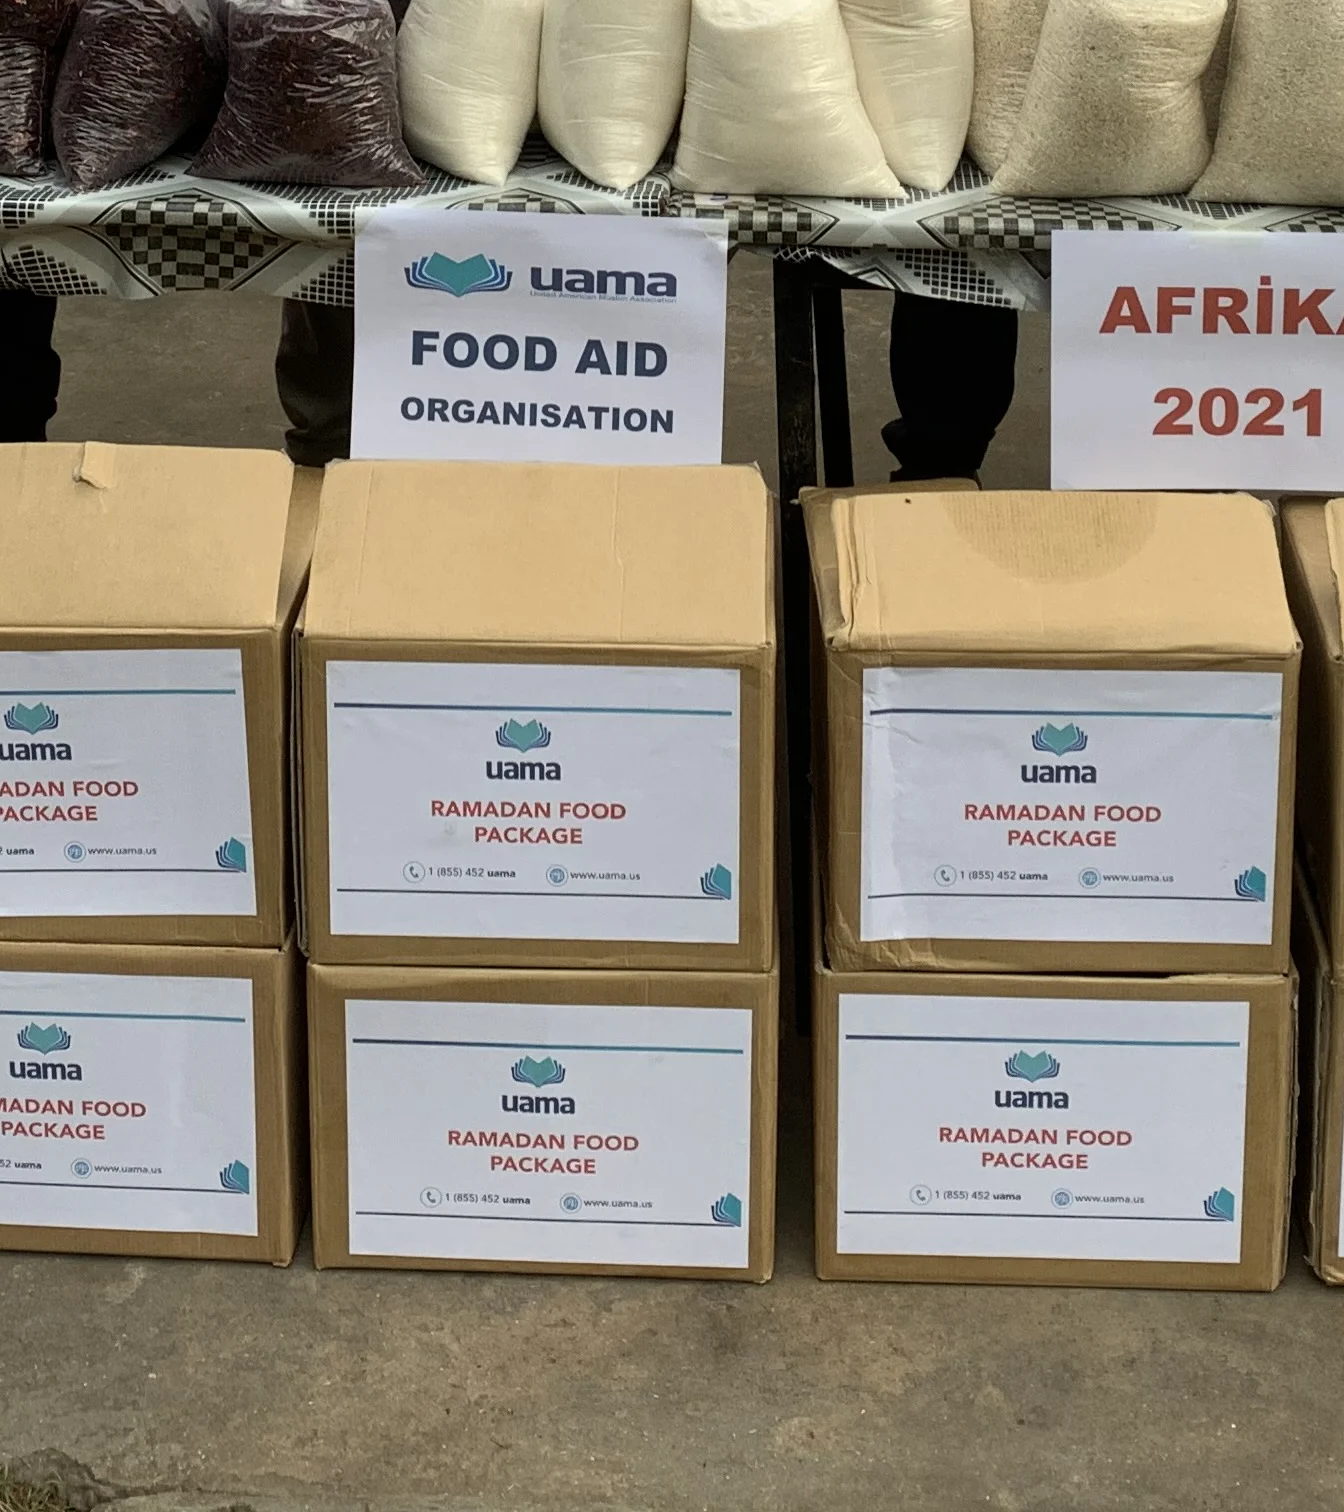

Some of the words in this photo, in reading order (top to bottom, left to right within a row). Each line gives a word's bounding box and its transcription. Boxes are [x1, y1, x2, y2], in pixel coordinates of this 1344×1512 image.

[531, 267, 677, 297] uama
[412, 331, 557, 371] FOOD
[575, 339, 667, 377] AID
[401, 397, 673, 433] ORGANISATION
[1153, 388, 1321, 436] 2021
[486, 761, 561, 780] uama
[1021, 765, 1096, 783] uama
[73, 781, 138, 796] FOOD
[432, 801, 550, 818] RAMADAN
[560, 803, 626, 819] FOOD
[965, 804, 1085, 821] RAMADAN
[1095, 805, 1161, 822] FOOD
[475, 827, 582, 844] PACKAGE
[1008, 830, 1116, 846] PACKAGE
[437, 867, 462, 877] (855)
[465, 868, 484, 877] 452
[570, 872, 640, 880] www.uama.us
[969, 871, 994, 881] (855)
[997, 871, 1016, 880] 452
[10, 1061, 82, 1081] uama
[502, 1095, 575, 1114] uama
[995, 1090, 1069, 1109] uama
[82, 1101, 146, 1117] FOOD
[1, 1121, 105, 1140] PACKAGE
[940, 1127, 1057, 1144] RAMADAN
[1067, 1130, 1132, 1146] FOOD
[449, 1131, 564, 1149] RAMADAN
[574, 1135, 639, 1151] FOOD
[491, 1156, 595, 1174] PACKAGE
[982, 1152, 1088, 1169] PACKAGE
[454, 1193, 478, 1203] (855)
[482, 1194, 499, 1203] 452
[584, 1200, 652, 1208] www.uama.us
[944, 1191, 968, 1200] (855)
[971, 1191, 990, 1200] 452
